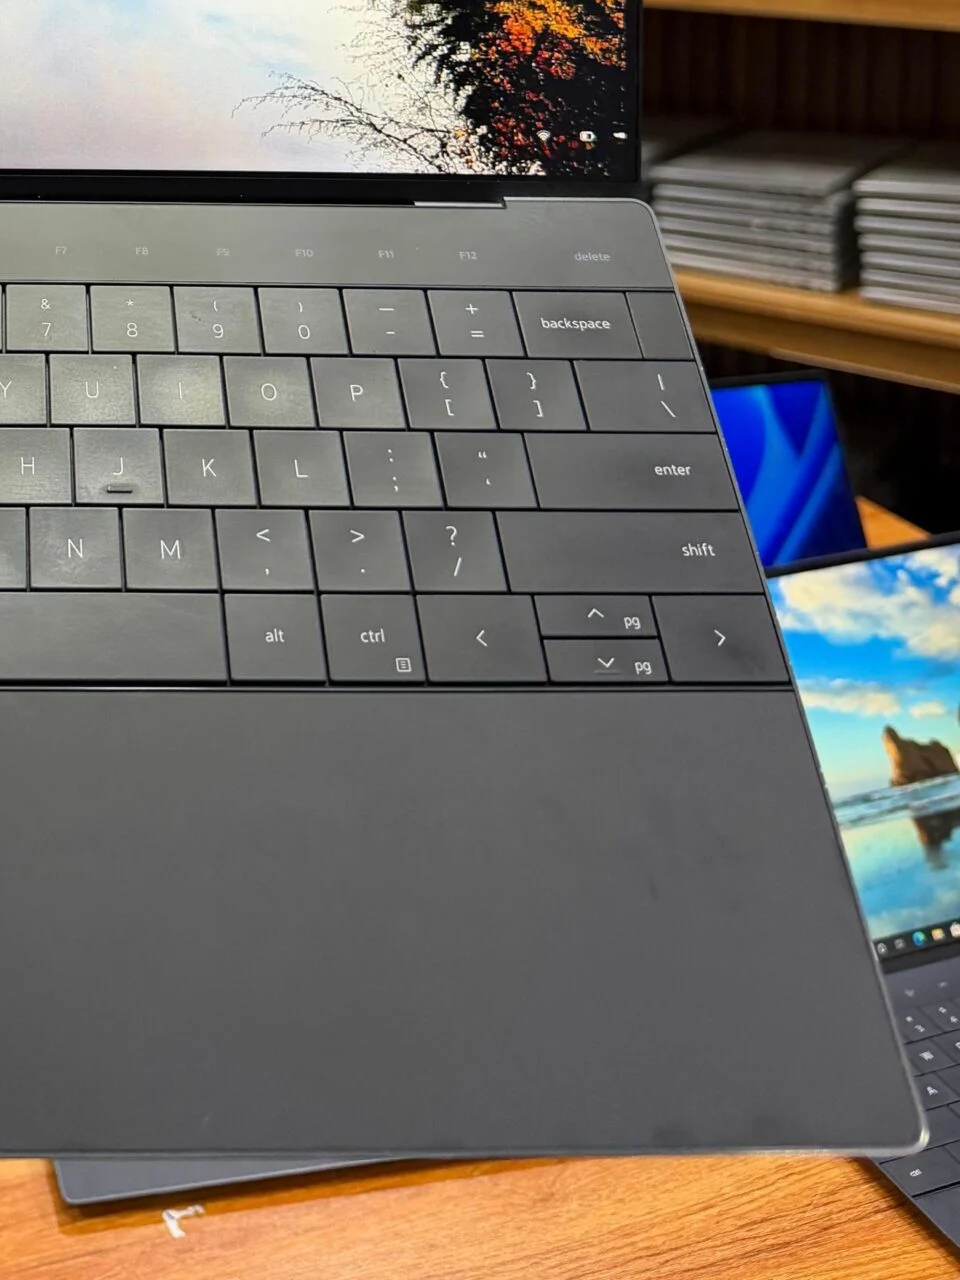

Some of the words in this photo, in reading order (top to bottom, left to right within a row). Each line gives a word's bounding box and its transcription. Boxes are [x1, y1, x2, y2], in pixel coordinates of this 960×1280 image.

[55, 245, 68, 255] F7
[135, 246, 149, 256] F8
[216, 247, 230, 257] F9
[294, 248, 314, 258] F10
[378, 249, 395, 259] F11
[458, 251, 478, 260] F12
[574, 251, 611, 262] delete
[40, 298, 51, 310] &
[465, 303, 479, 315] +
[41, 322, 52, 337] 7
[126, 322, 138, 338] 8
[212, 323, 224, 339] 9
[297, 324, 311, 340] 0
[540, 317, 611, 332] backspace
[470, 330, 485, 338] =
[439, 371, 449, 389] {
[526, 372, 537, 390] }
[85, 381, 100, 399] U
[261, 382, 278, 402] O
[349, 384, 364, 402] P
[444, 398, 455, 417] [
[533, 399, 544, 418] ]
[660, 400, 676, 418] \
[20, 456, 35, 475] H
[112, 456, 124, 476] J
[201, 458, 217, 477] K
[294, 459, 309, 478] L
[654, 464, 691, 476] enter
[445, 525, 458, 546] ?
[67, 538, 84, 559] N
[160, 539, 181, 560] M
[681, 542, 716, 557] shift
[453, 557, 462, 577] /
[623, 616, 641, 630] pg
[265, 628, 285, 643] alt
[360, 628, 386, 643] ctrl
[634, 661, 652, 675] pg
